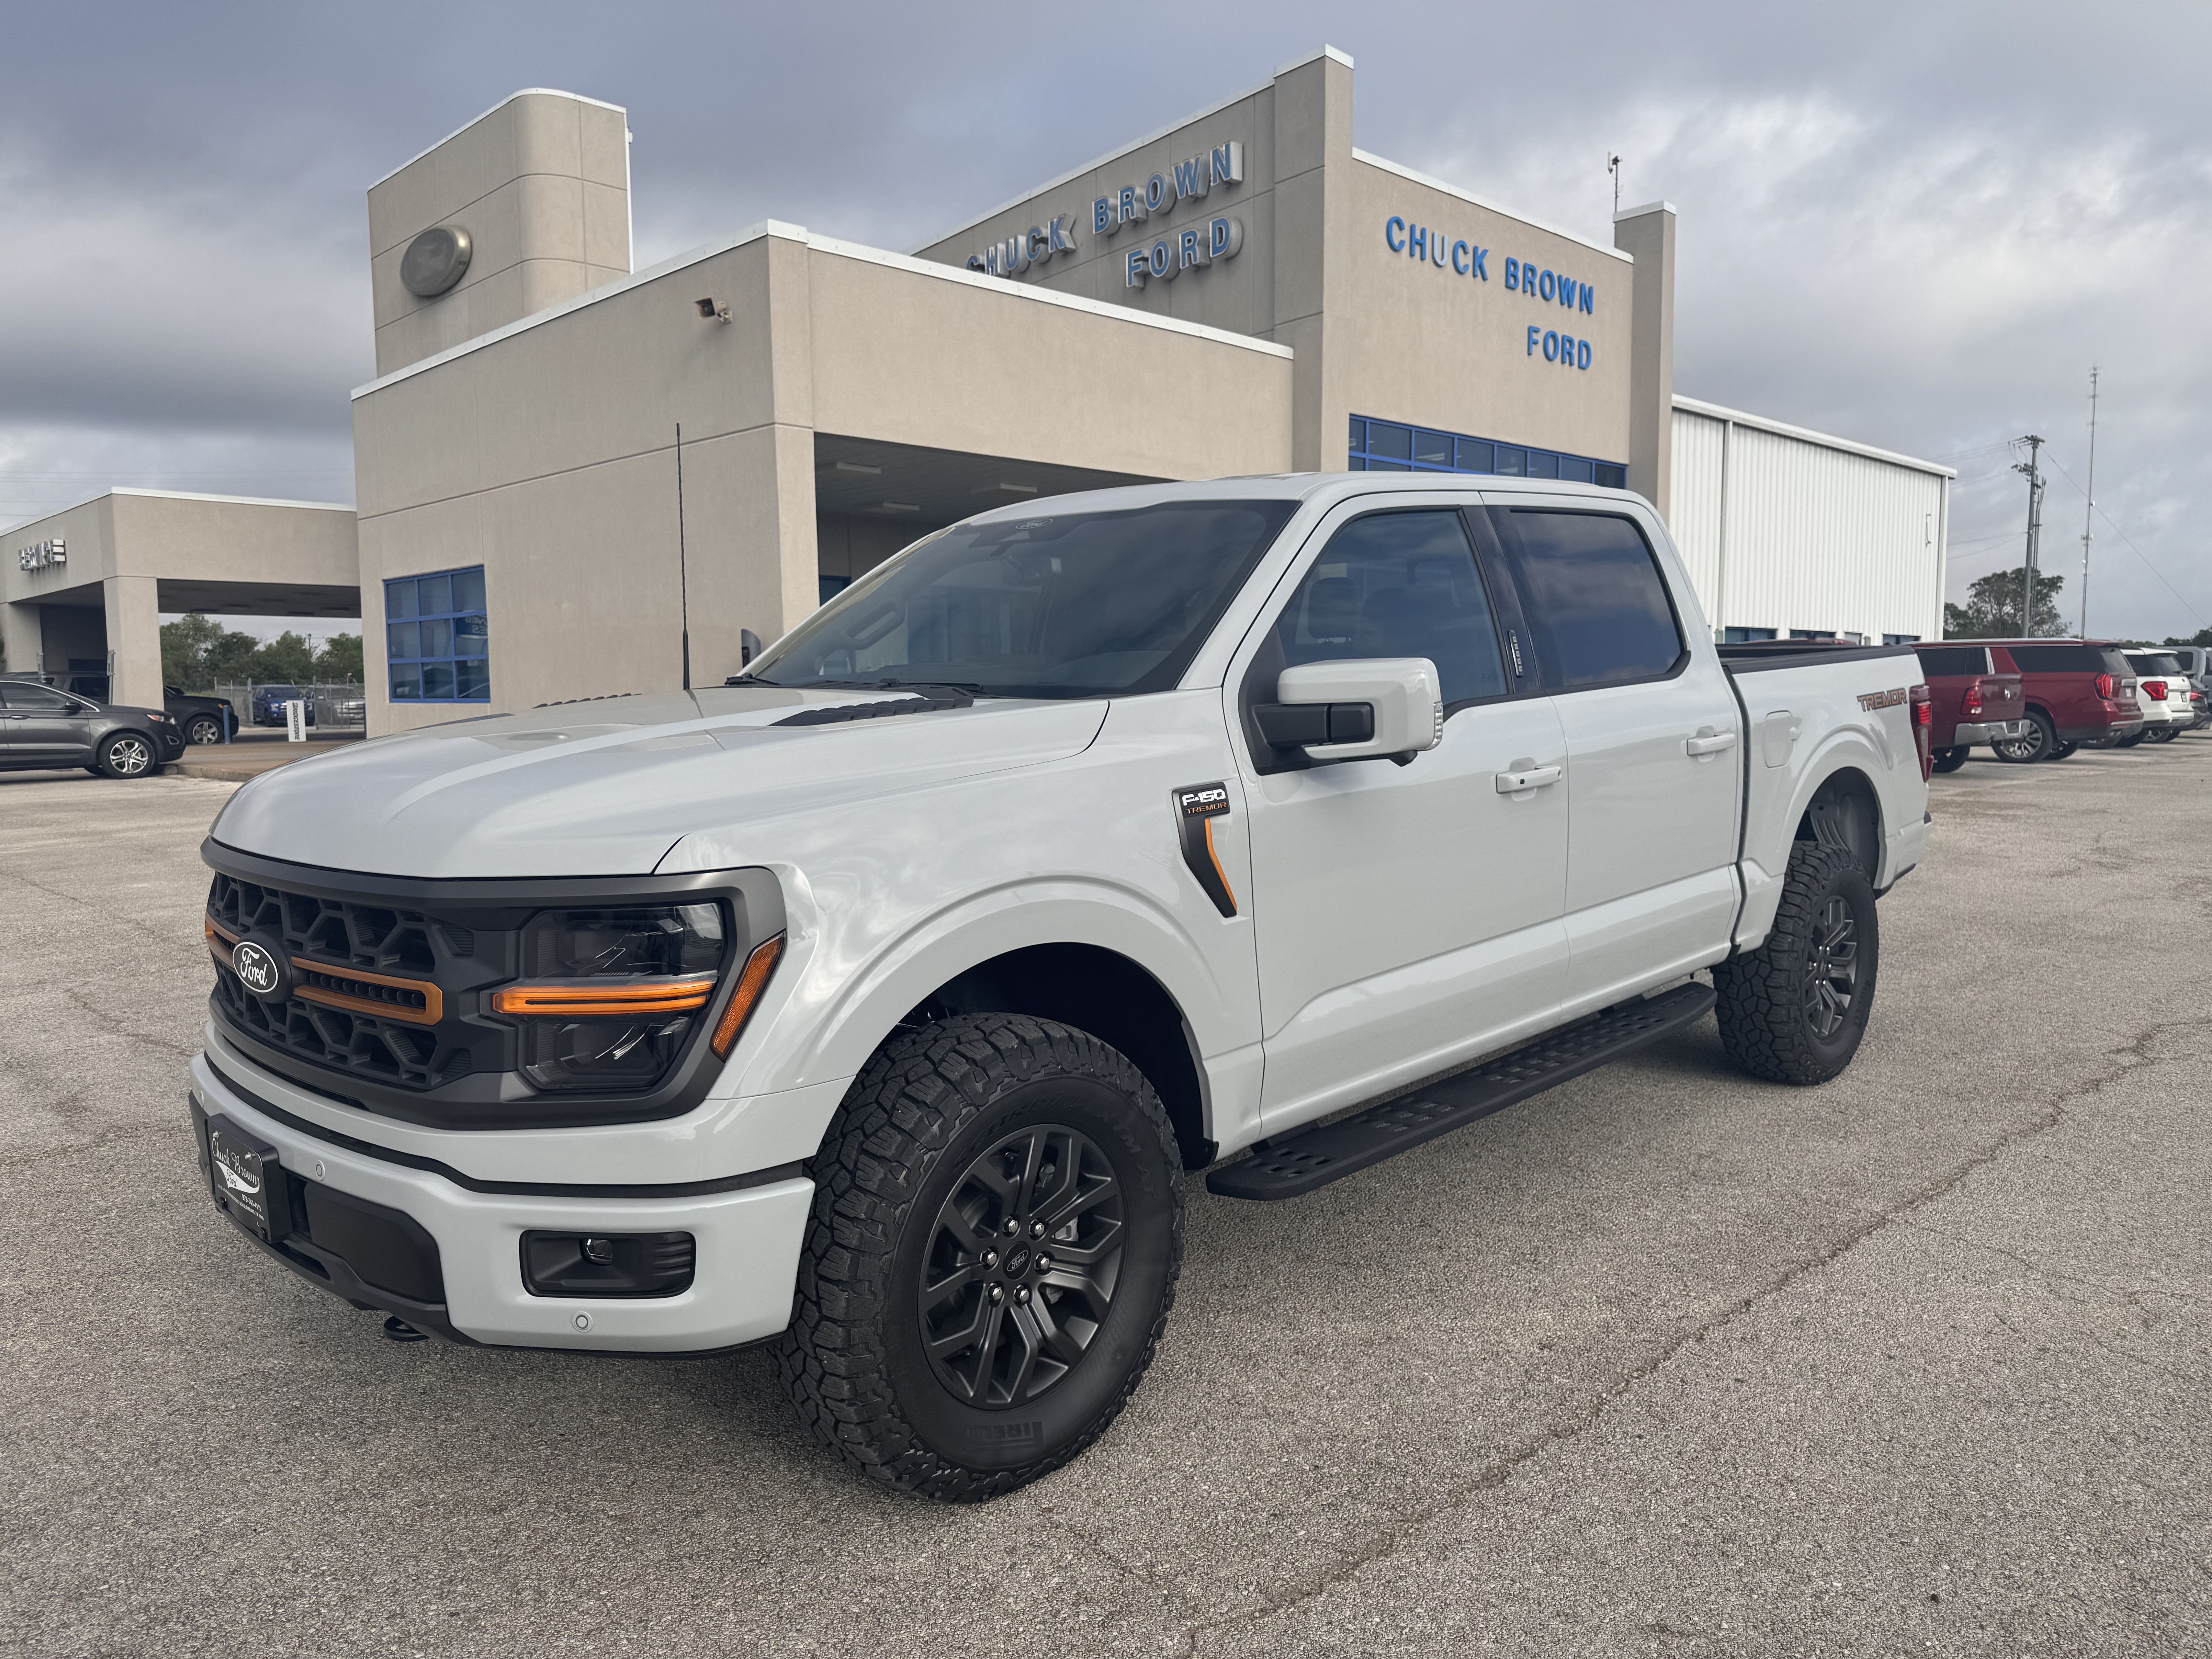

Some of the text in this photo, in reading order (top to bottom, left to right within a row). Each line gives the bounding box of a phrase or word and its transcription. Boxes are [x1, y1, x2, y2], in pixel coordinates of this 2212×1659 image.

[1092, 141, 1242, 234] BROWN
[1125, 216, 1241, 288] FORD
[1387, 216, 1594, 315] CHUCK BROWN
[1527, 325, 1592, 369] FORD
[1856, 688, 1907, 712] TREMOR
[1182, 788, 1226, 806] F-150
[1185, 802, 1226, 814] TREMOR
[240, 948, 267, 986] Ford
[212, 1138, 260, 1186] Chuck Brown
[226, 1169, 237, 1187] Ford
[1011, 1253, 1025, 1269] Ford
